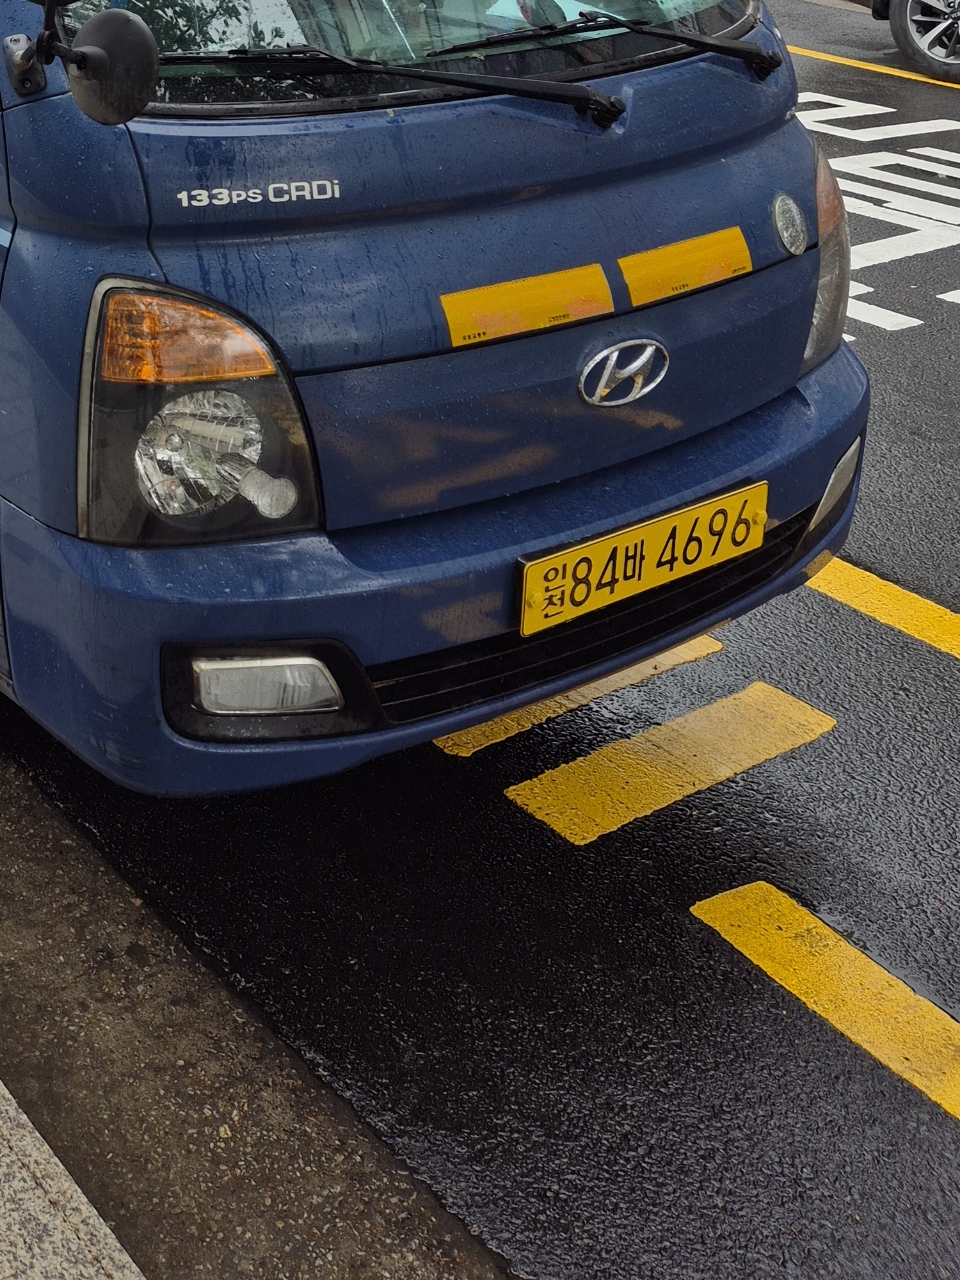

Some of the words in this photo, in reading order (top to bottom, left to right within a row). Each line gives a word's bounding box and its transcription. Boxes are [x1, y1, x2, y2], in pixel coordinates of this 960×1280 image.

[268, 180, 340, 203] CRDi
[542, 563, 567, 619] 인천
[569, 539, 646, 608] 84바
[656, 499, 752, 573] 4696
